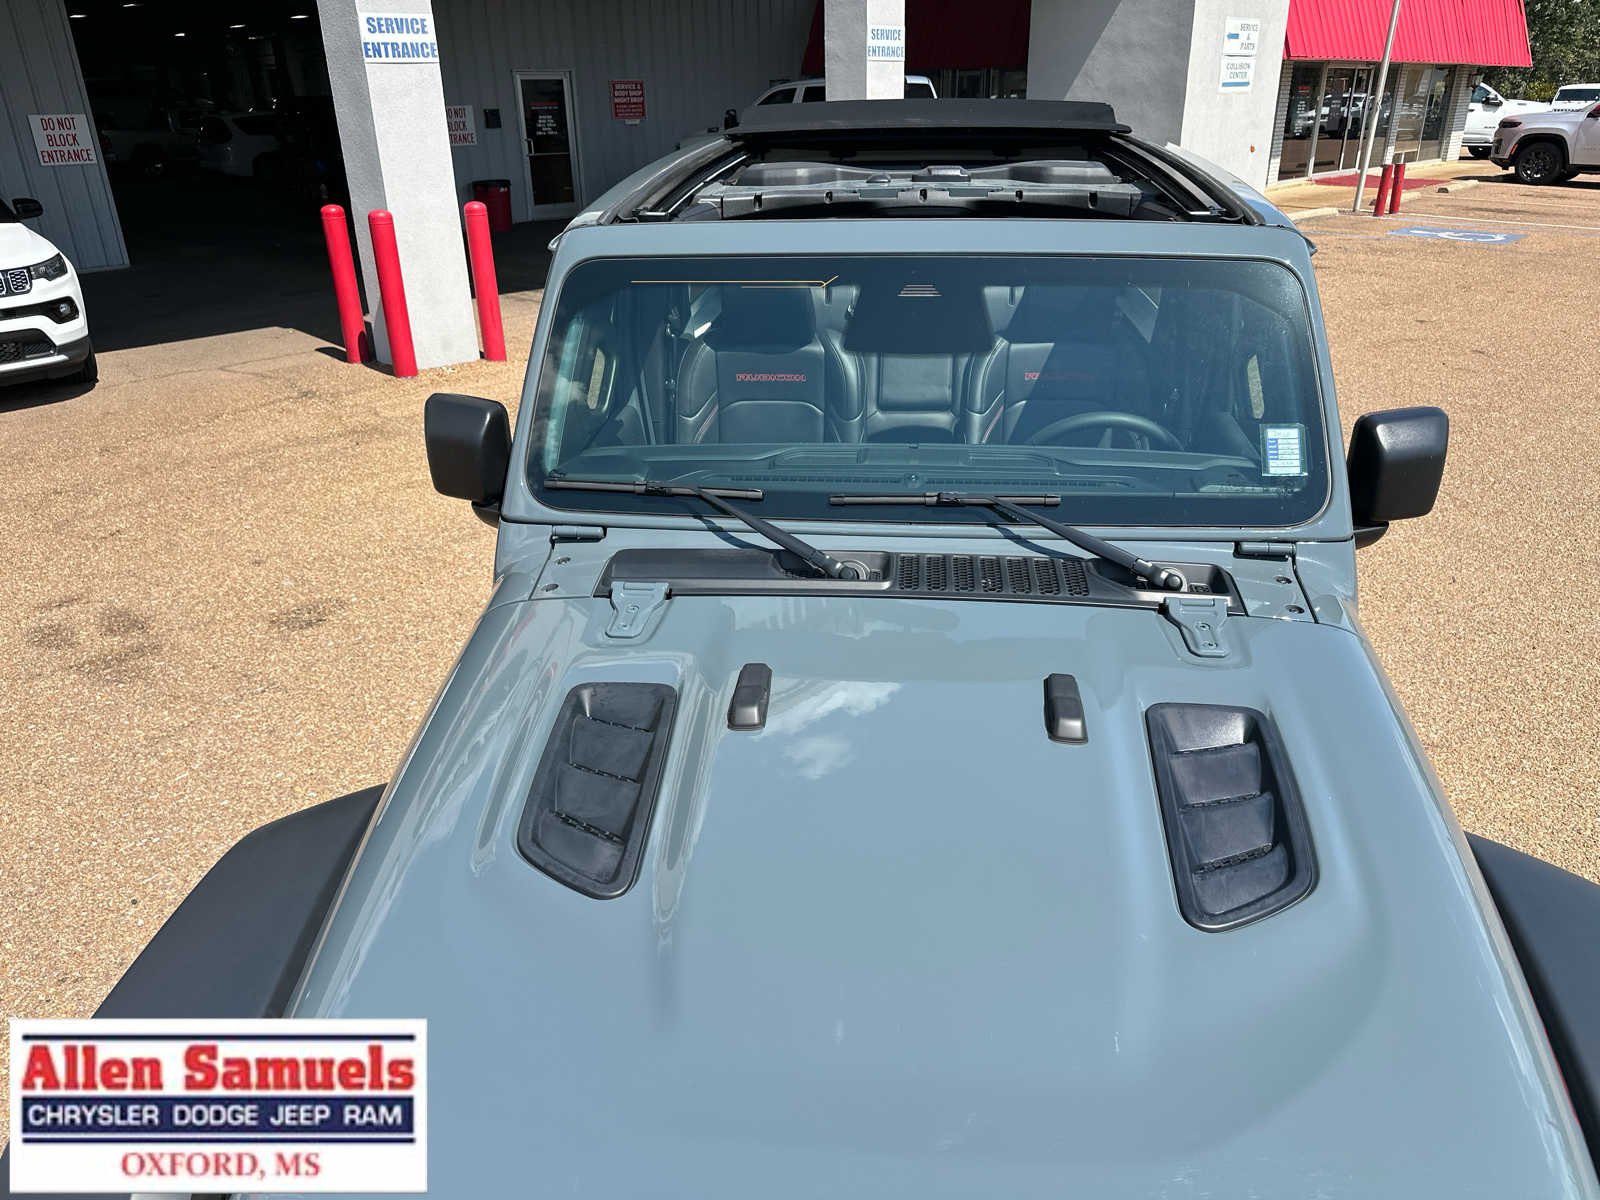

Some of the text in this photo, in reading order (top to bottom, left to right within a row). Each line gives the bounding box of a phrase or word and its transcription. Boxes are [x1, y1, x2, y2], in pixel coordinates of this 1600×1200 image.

[366, 16, 429, 34] SERVICE
[871, 28, 902, 40] SERVICE
[363, 41, 439, 58] ENTRANCE
[868, 46, 904, 57] ENTRANCE
[1226, 62, 1251, 70] COLLISION
[453, 107, 465, 118] NOT
[40, 117, 77, 131] DO NOT
[46, 133, 80, 147] BLOCK
[450, 132, 475, 145] TRANCE
[40, 148, 94, 164] ENTRANCE
